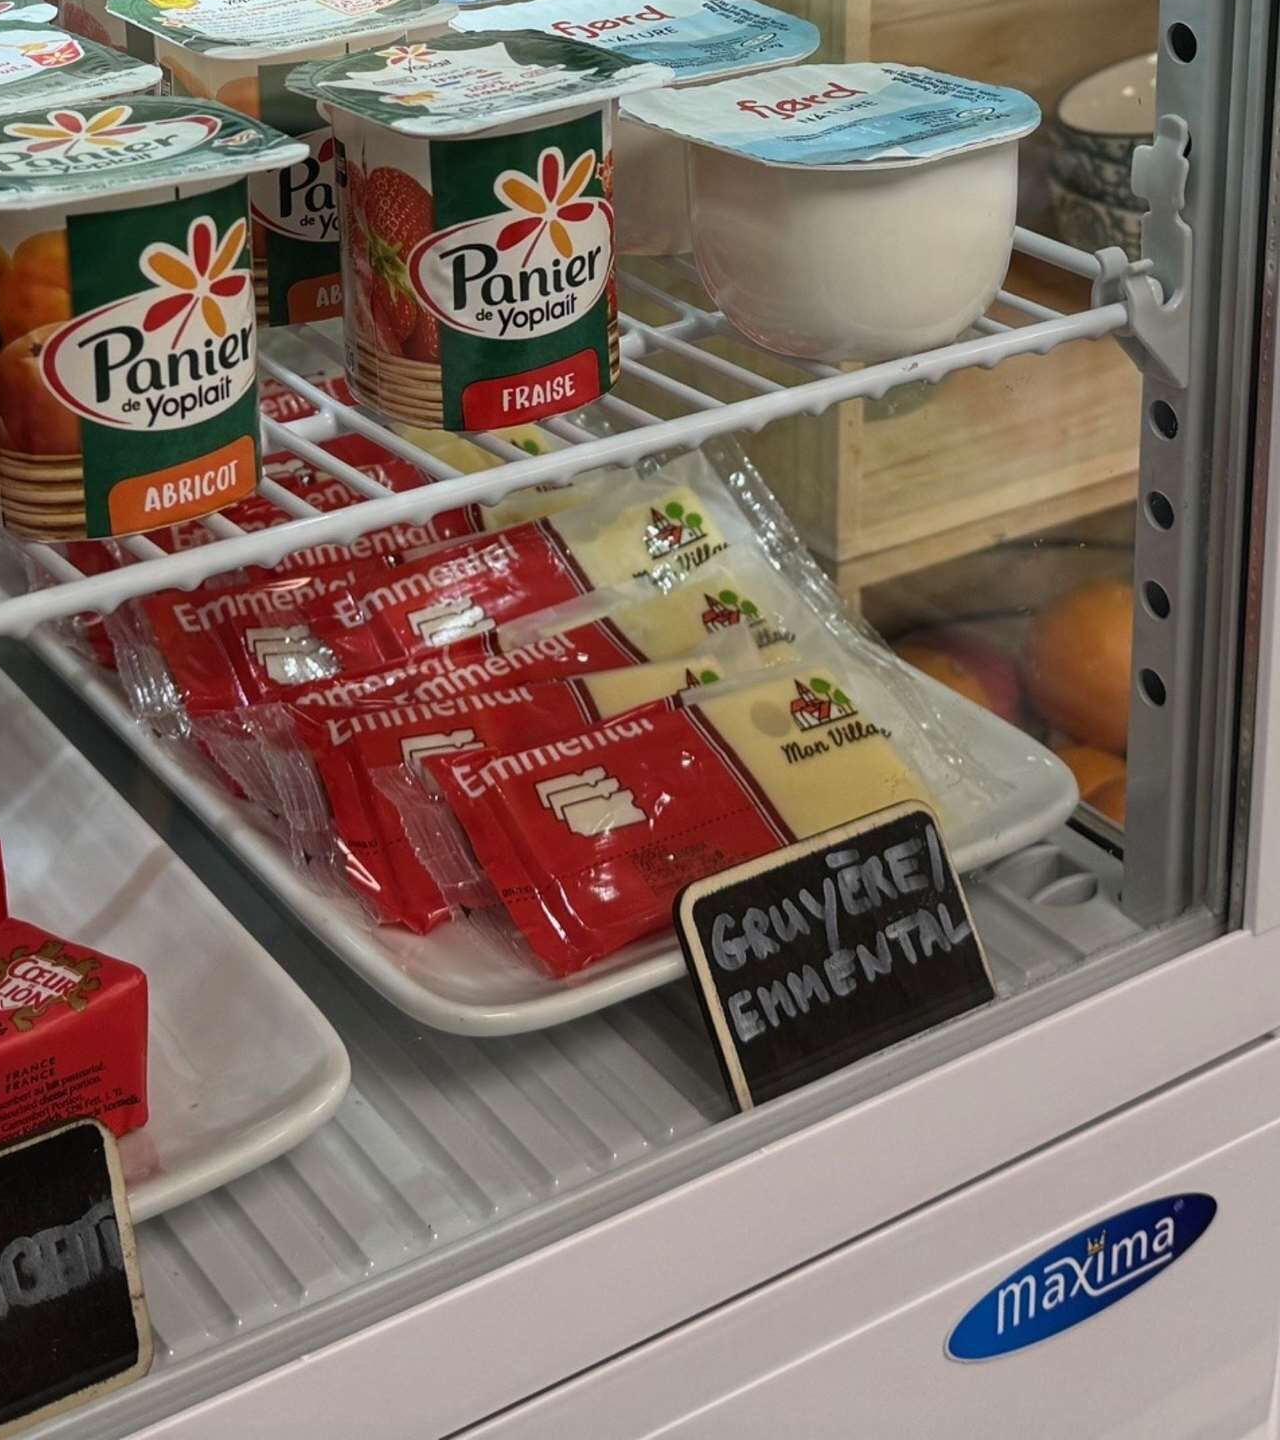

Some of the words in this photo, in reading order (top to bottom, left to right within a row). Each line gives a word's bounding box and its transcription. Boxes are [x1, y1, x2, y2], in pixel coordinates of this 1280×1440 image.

[299, 215, 315, 227] de
[437, 243, 604, 311] Panier
[474, 306, 494, 322] de
[497, 291, 578, 338] Yoplait
[78, 320, 253, 405] Panier
[121, 398, 142, 414] de
[145, 376, 233, 429] Yoplait
[500, 371, 576, 414] FRAISE
[143, 459, 240, 513] ABRICOT
[272, 520, 439, 573] mmental
[780, 740, 830, 765] Mon
[727, 902, 972, 1043] EMMENTAL
[4, 1056, 57, 1082] FRANCE
[4, 1067, 57, 1093] FRANCE
[996, 1215, 1176, 1335] maxima
